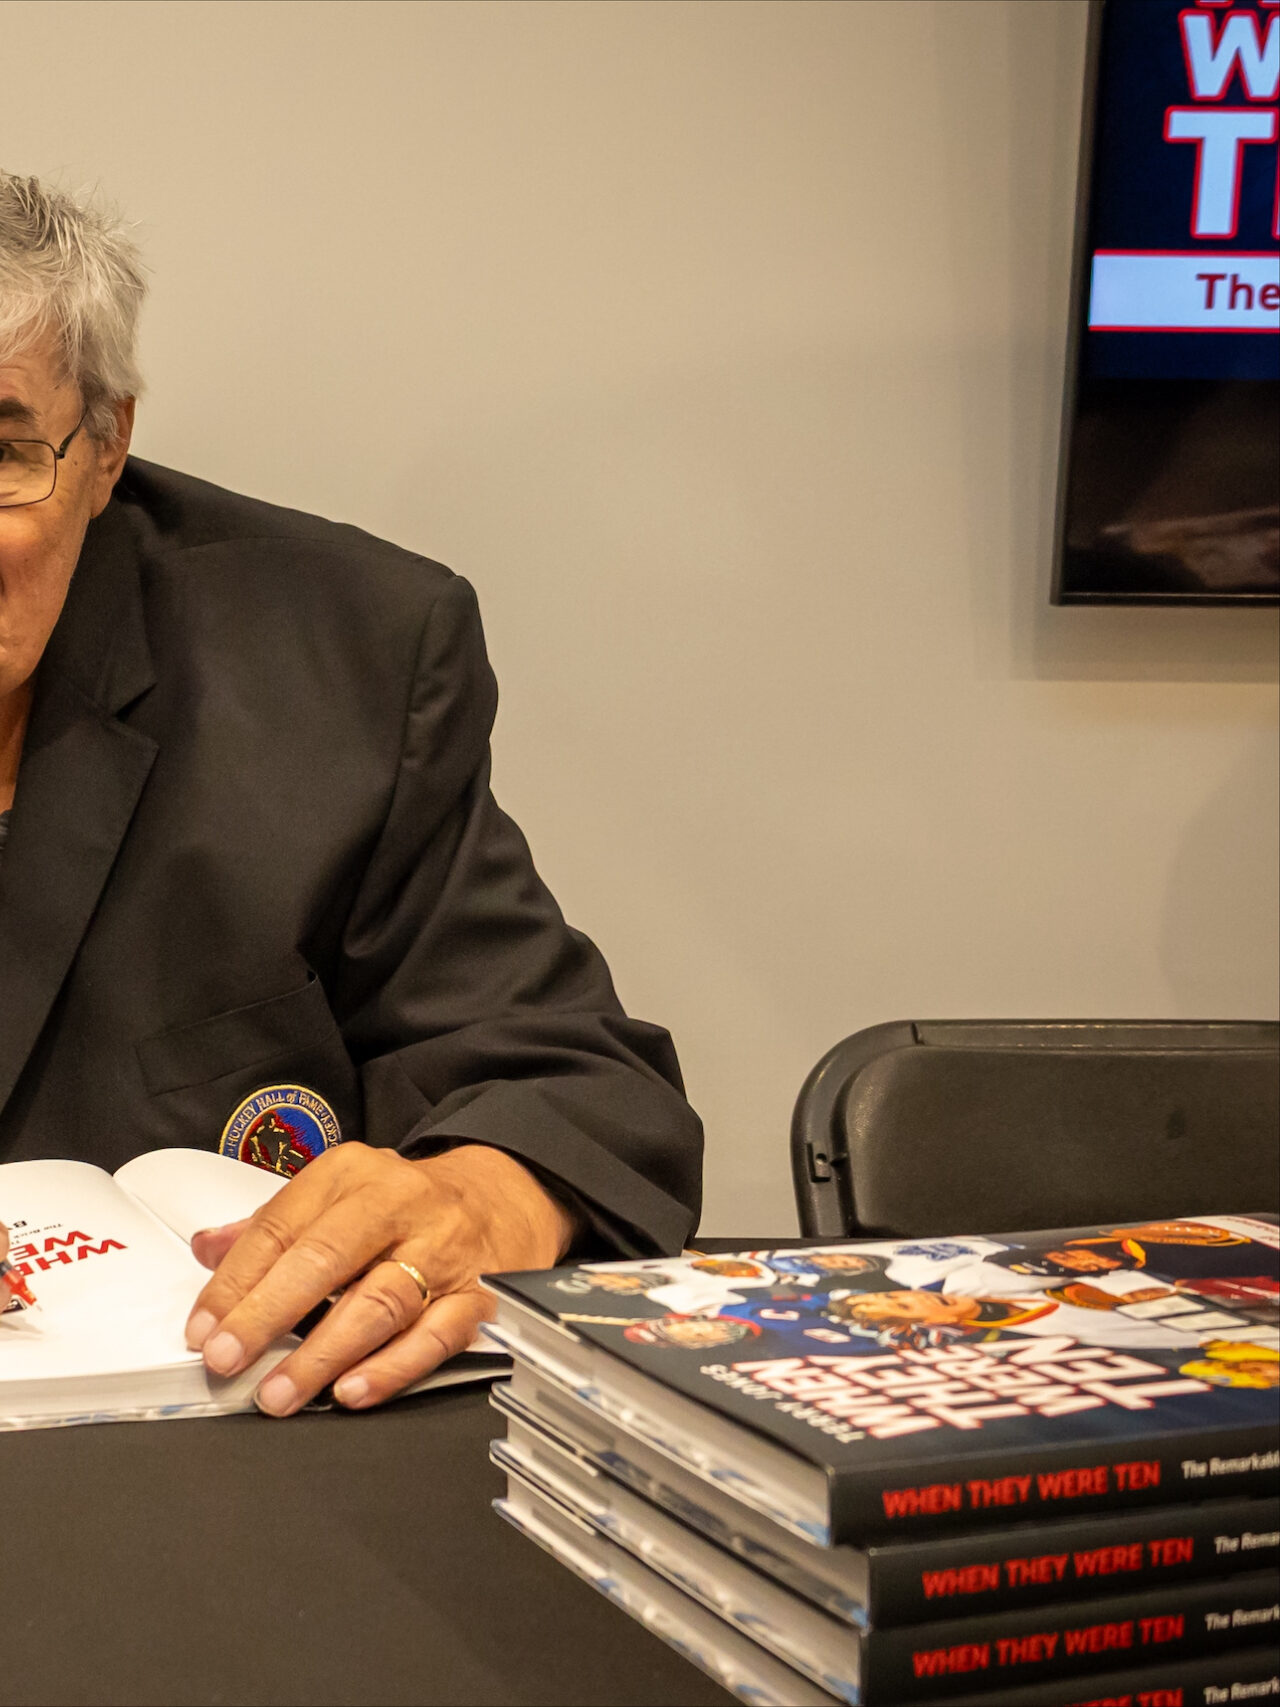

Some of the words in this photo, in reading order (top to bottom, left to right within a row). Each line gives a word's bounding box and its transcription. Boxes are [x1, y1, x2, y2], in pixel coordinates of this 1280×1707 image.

[1196, 273, 1280, 310] The
[227, 1104, 257, 1147] HOCKEY
[256, 1092, 285, 1112] HALL
[286, 1091, 298, 1105] of
[299, 1092, 324, 1115] FAME
[321, 1114, 340, 1147] OCKEY
[9, 1230, 93, 1261] WE
[14, 1239, 127, 1277] WHE
[731, 1356, 943, 1440] WHEN
[805, 1353, 1032, 1430] THEY
[896, 1344, 1109, 1418] WERE
[973, 1333, 1214, 1411] TEN
[882, 1483, 963, 1519] WHEN
[966, 1474, 1032, 1509] THEY
[1037, 1466, 1108, 1501] WERE
[1113, 1460, 1160, 1491] TEN
[1180, 1459, 1207, 1480] The
[1209, 1450, 1280, 1476] Remarkabl
[922, 1563, 1000, 1599] WHEN
[1004, 1553, 1070, 1588] THEY
[1074, 1542, 1143, 1578] WERE
[1148, 1536, 1194, 1567] TEN
[1214, 1535, 1240, 1554] The
[1241, 1531, 1280, 1550] Rema
[912, 1642, 991, 1678] WHEN
[995, 1631, 1059, 1666] THEY
[1064, 1620, 1134, 1656] WERE
[1138, 1613, 1185, 1645] TEN
[1204, 1611, 1231, 1632] The
[1203, 1684, 1230, 1706] The
